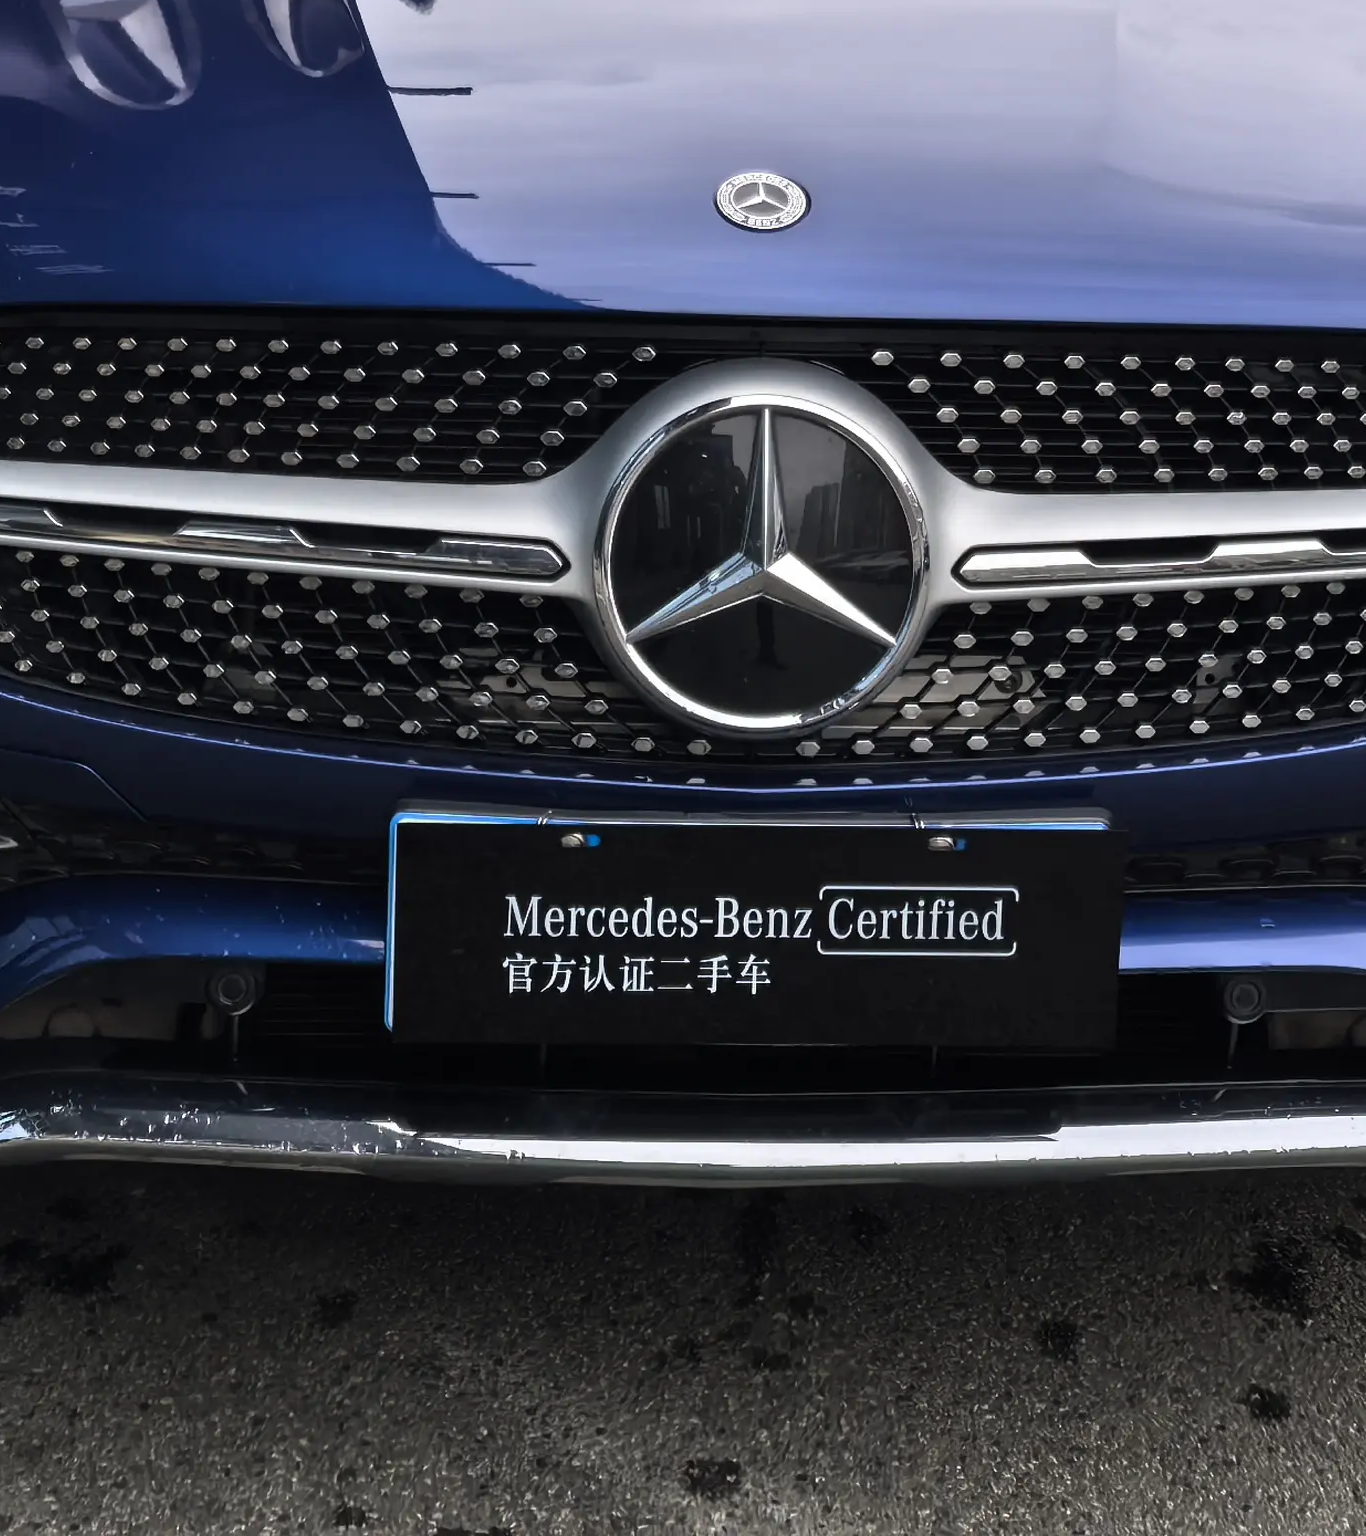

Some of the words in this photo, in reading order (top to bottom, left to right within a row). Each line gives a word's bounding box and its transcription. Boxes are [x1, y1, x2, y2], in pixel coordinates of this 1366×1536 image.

[504, 895, 813, 940] Mercedes-Benz
[828, 898, 1005, 941] Certified
[502, 953, 771, 995] 官方认证二手车
